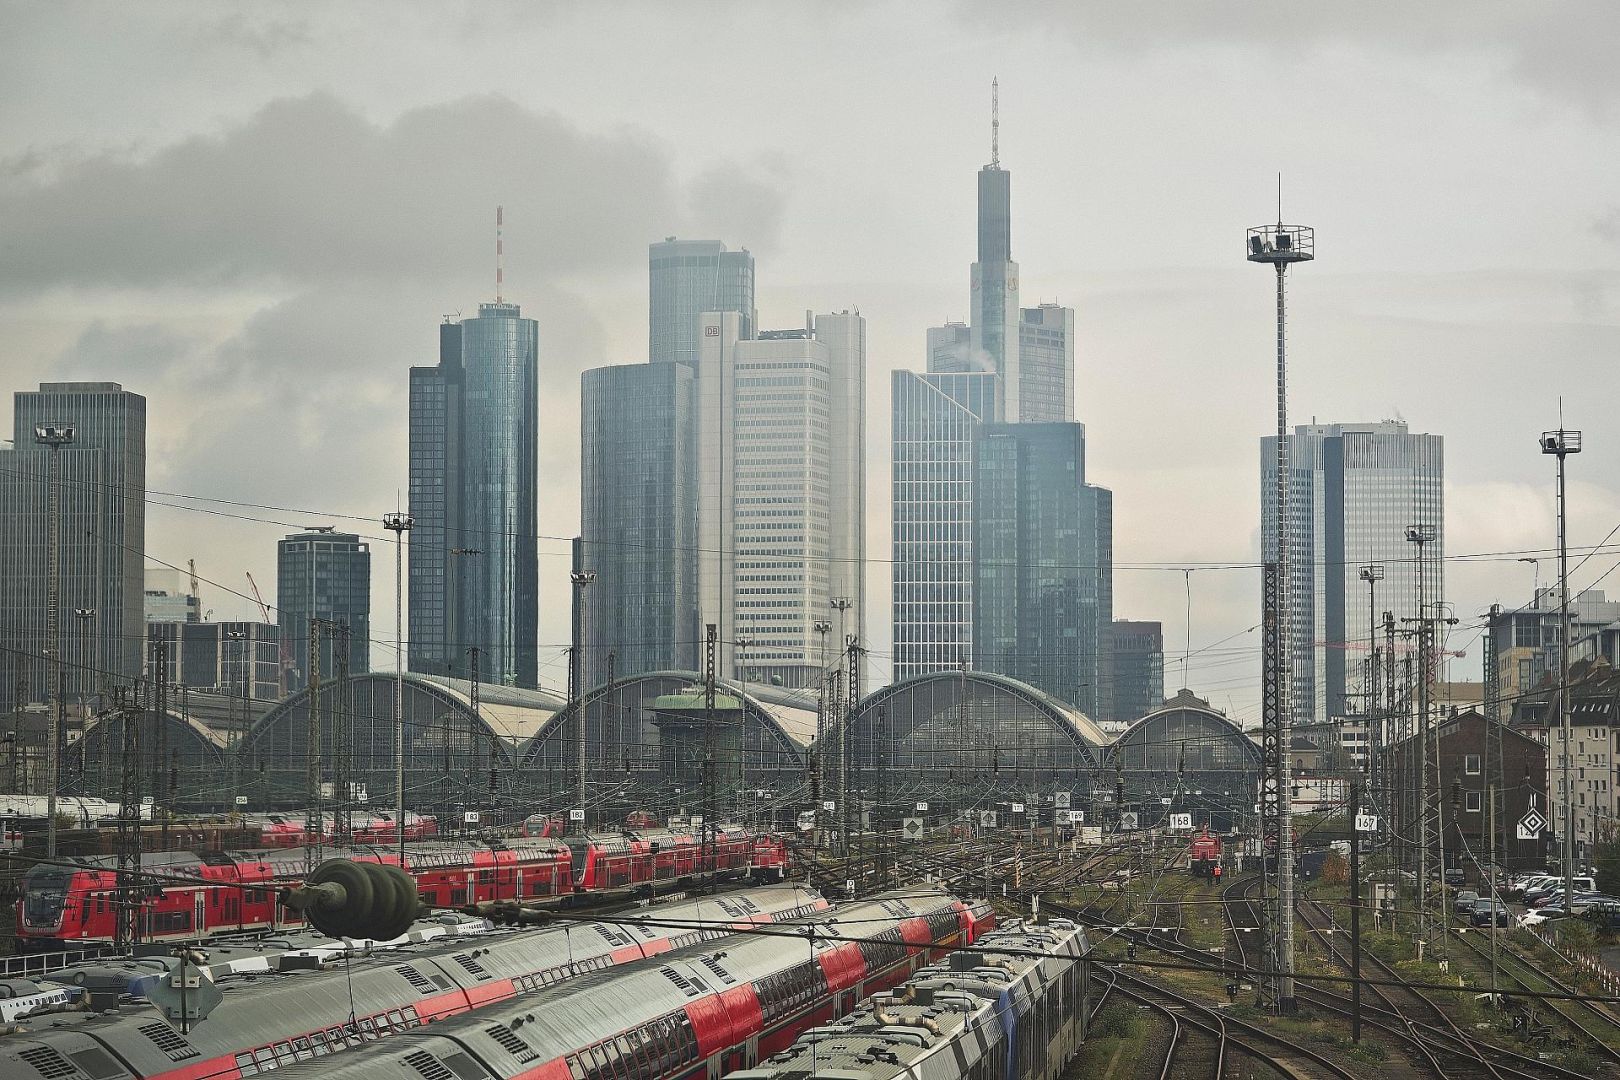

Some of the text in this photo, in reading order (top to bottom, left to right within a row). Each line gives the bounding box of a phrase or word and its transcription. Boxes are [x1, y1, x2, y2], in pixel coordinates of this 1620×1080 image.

[706, 327, 719, 335] DB
[1172, 816, 1189, 825] 168
[1358, 817, 1375, 828] 167
